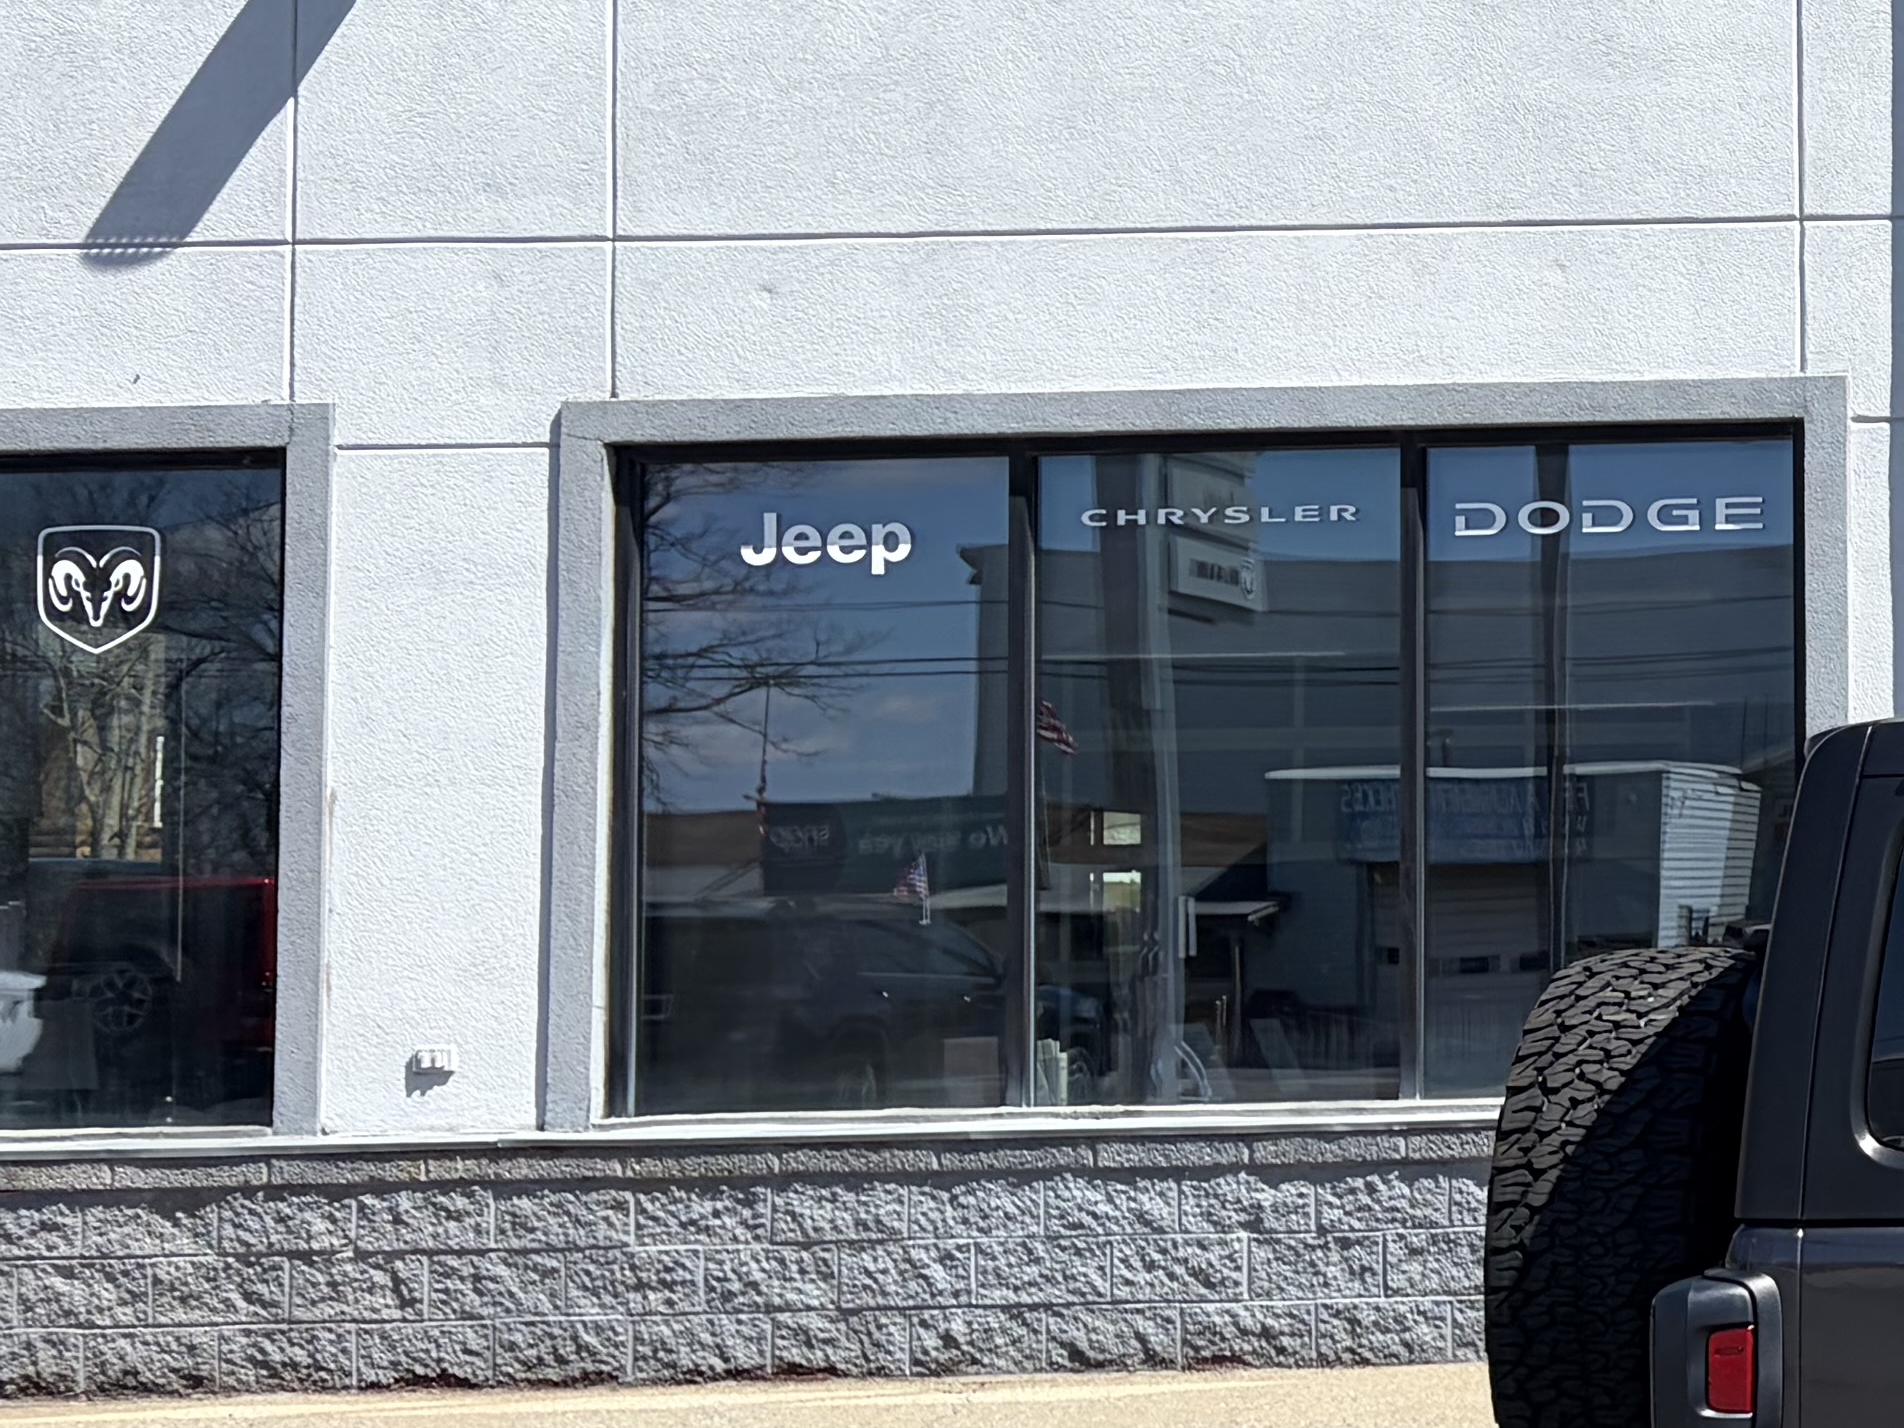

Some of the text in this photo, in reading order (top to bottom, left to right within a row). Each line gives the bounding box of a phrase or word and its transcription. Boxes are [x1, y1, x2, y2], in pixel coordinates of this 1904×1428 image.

[1080, 504, 1357, 528] CHRYSLER
[1454, 496, 1764, 537] DODGE
[739, 512, 912, 575] Jeep
